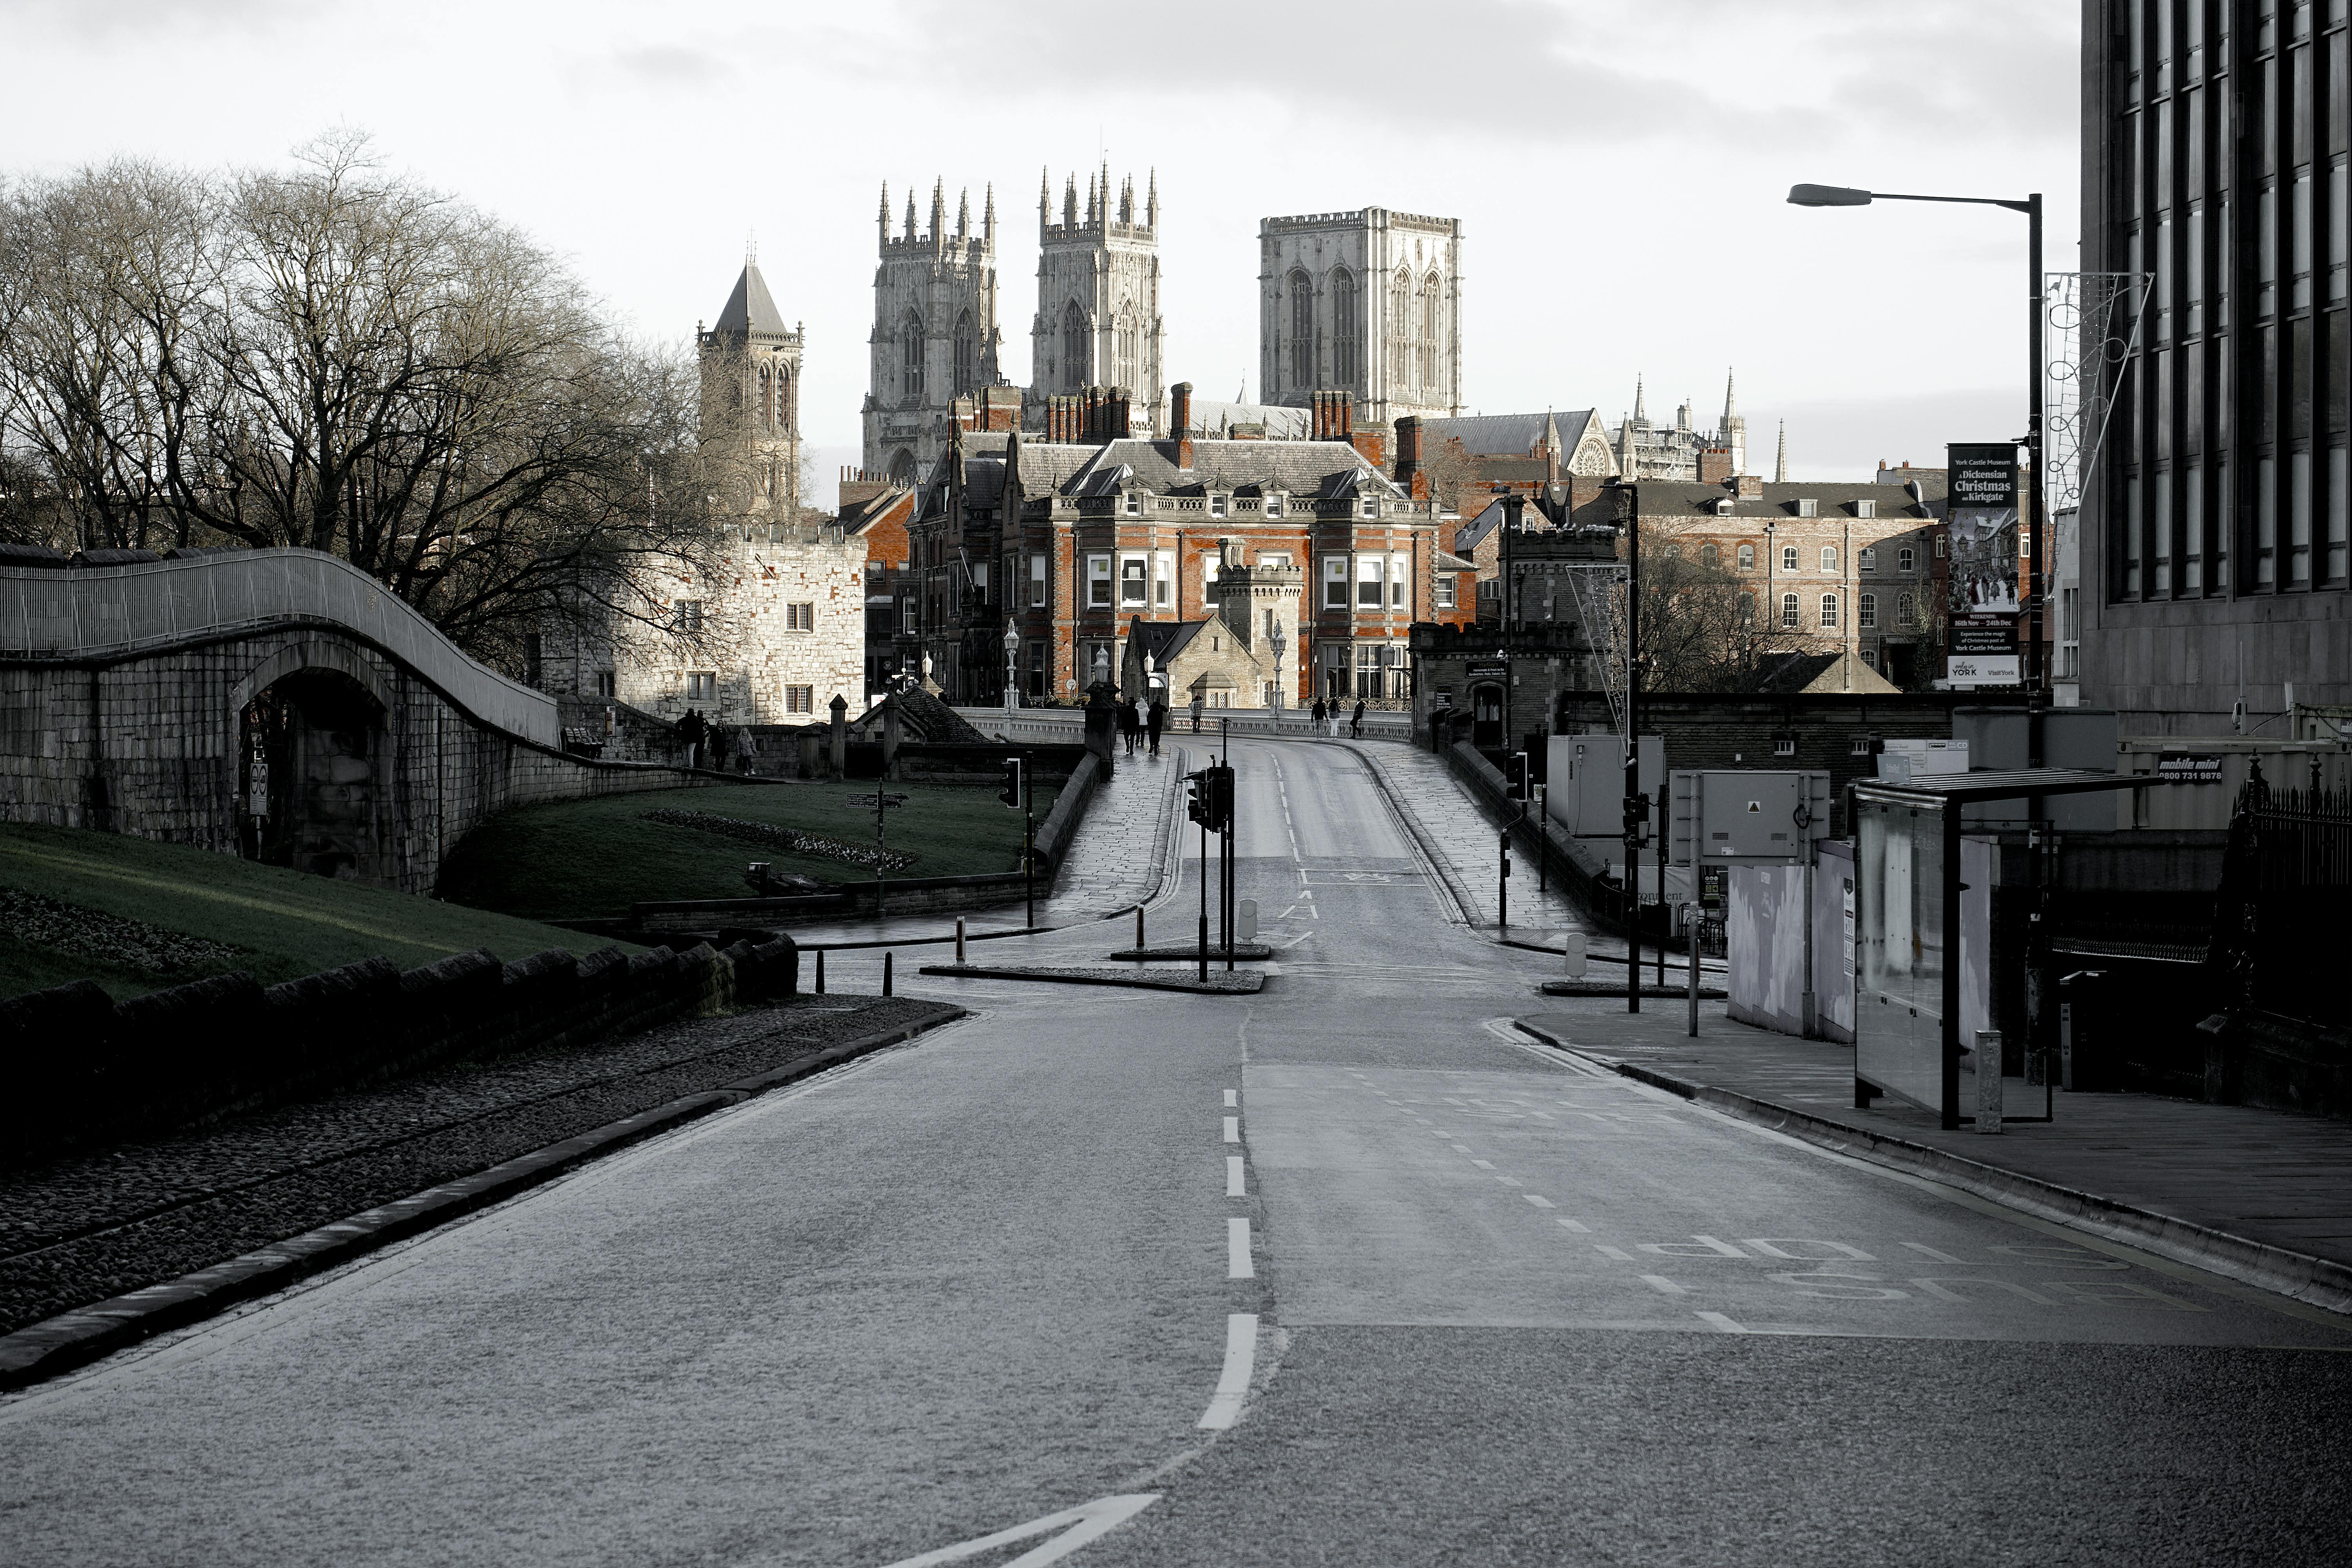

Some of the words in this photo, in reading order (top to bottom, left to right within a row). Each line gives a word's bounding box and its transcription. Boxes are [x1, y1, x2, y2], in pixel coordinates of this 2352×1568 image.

[1962, 470, 2007, 479] Dickensian
[1955, 480, 2011, 492] Christmas
[1968, 492, 2004, 503] Kirkgate
[2159, 758, 2195, 769] mobile
[2195, 759, 2220, 769] mini
